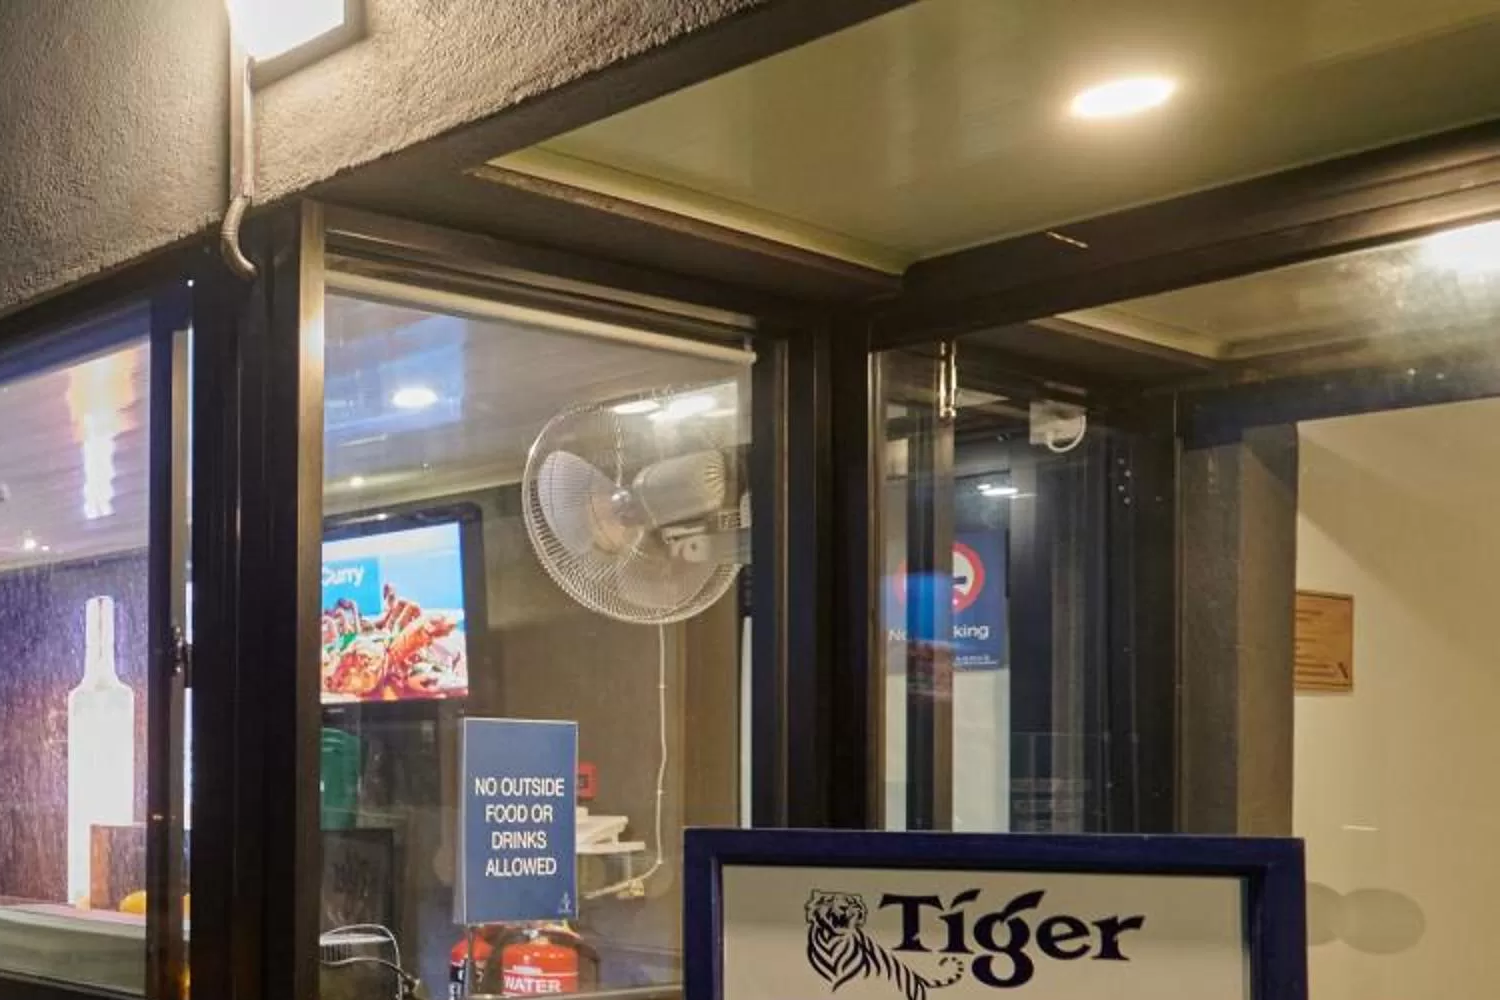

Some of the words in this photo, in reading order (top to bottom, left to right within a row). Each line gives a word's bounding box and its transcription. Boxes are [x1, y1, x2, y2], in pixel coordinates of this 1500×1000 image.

[475, 777, 497, 797] NO
[501, 777, 565, 797] OUTSIDE
[485, 804, 528, 823] FOOD
[531, 804, 553, 823] OR
[491, 831, 547, 849] DRINKS
[485, 857, 557, 877] ALLOWED
[879, 888, 1145, 989] Tiger
[503, 975, 562, 993] WATER
